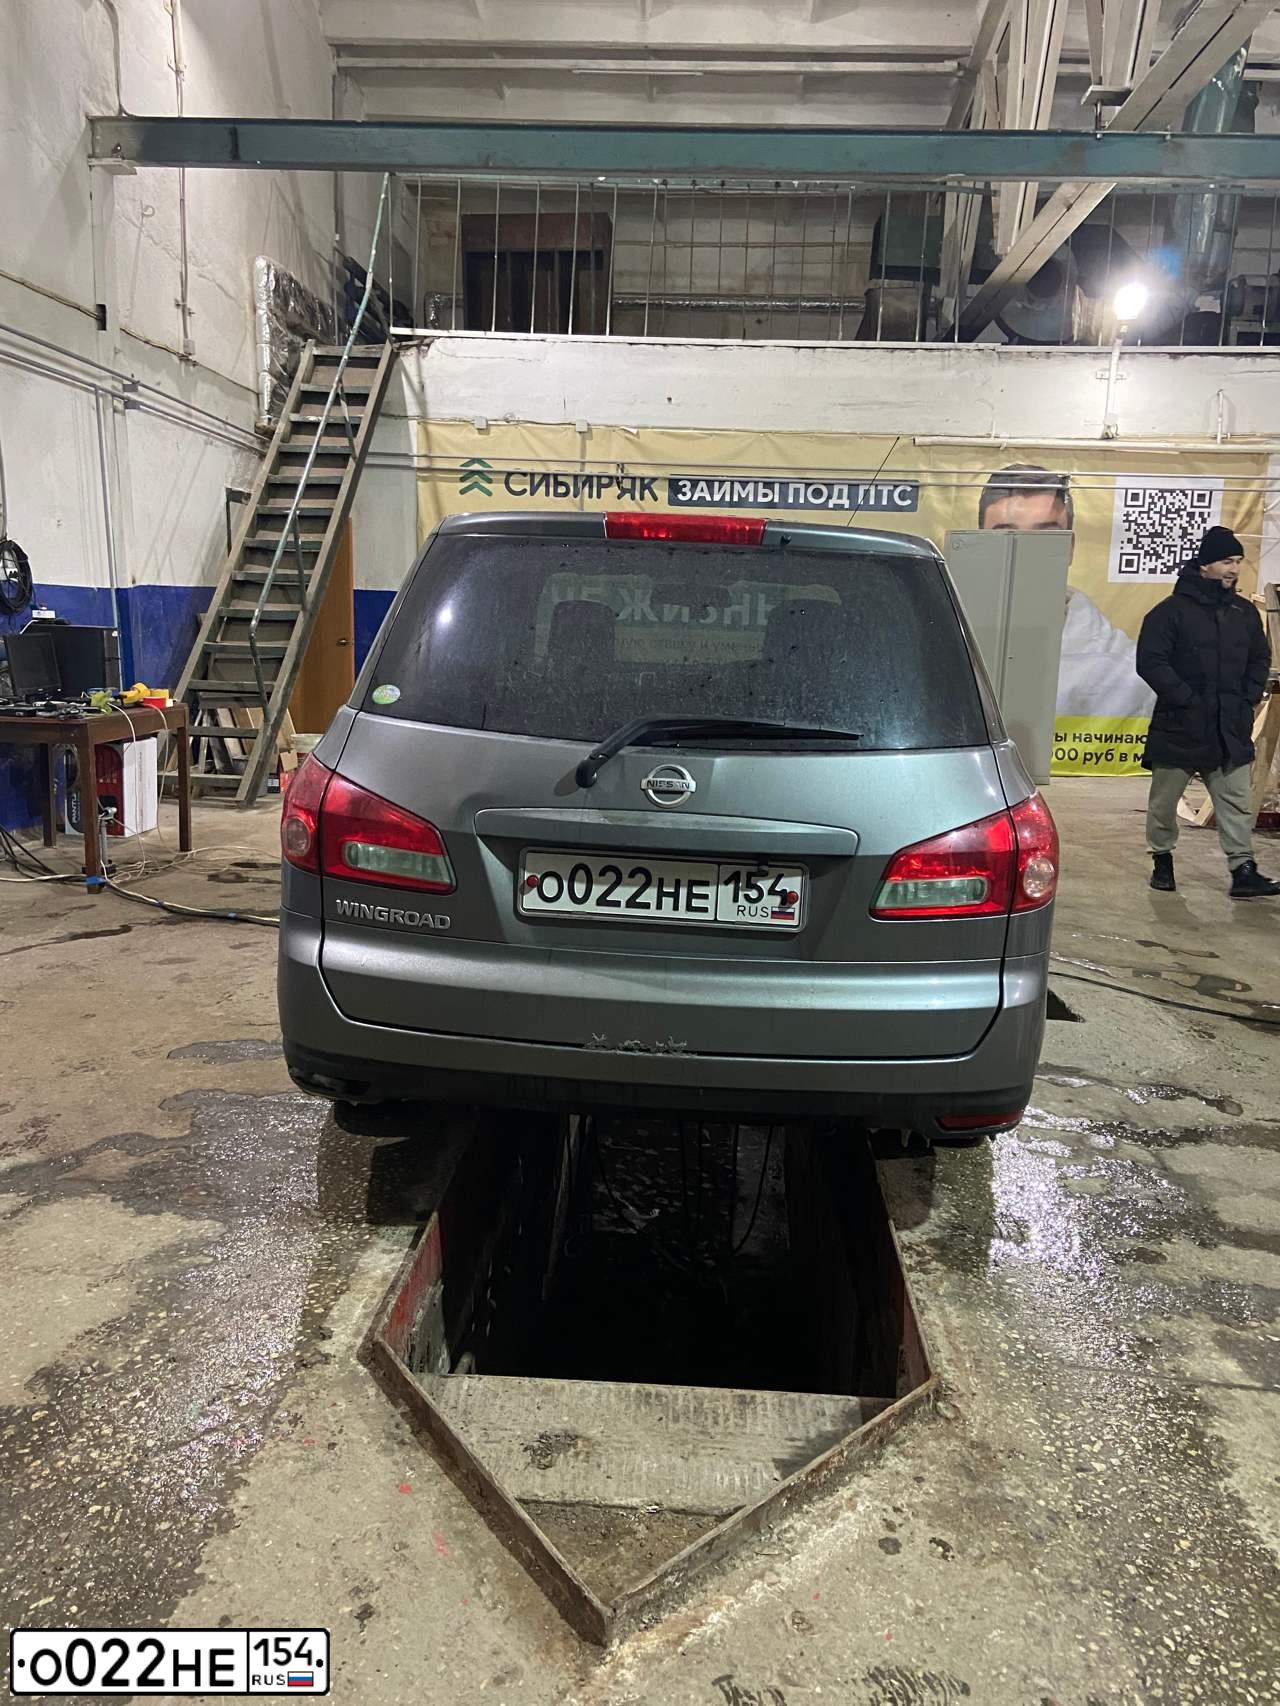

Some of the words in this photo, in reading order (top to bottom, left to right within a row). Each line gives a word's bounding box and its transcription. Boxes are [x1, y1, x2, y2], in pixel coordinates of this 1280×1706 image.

[504, 472, 658, 502] СИБИРЯК
[788, 482, 850, 509] ПОД
[858, 484, 913, 506] ПТС
[1054, 733, 1068, 743] ы
[1072, 733, 1148, 744] начинаю
[1052, 748, 1079, 761] 00
[1082, 748, 1116, 765] руб
[1119, 752, 1129, 762] в
[1133, 753, 1145, 763] м
[536, 863, 709, 914] О022НЕ
[723, 871, 789, 906] 154
[336, 899, 451, 930] WINGROAD
[736, 905, 770, 918] RUS
